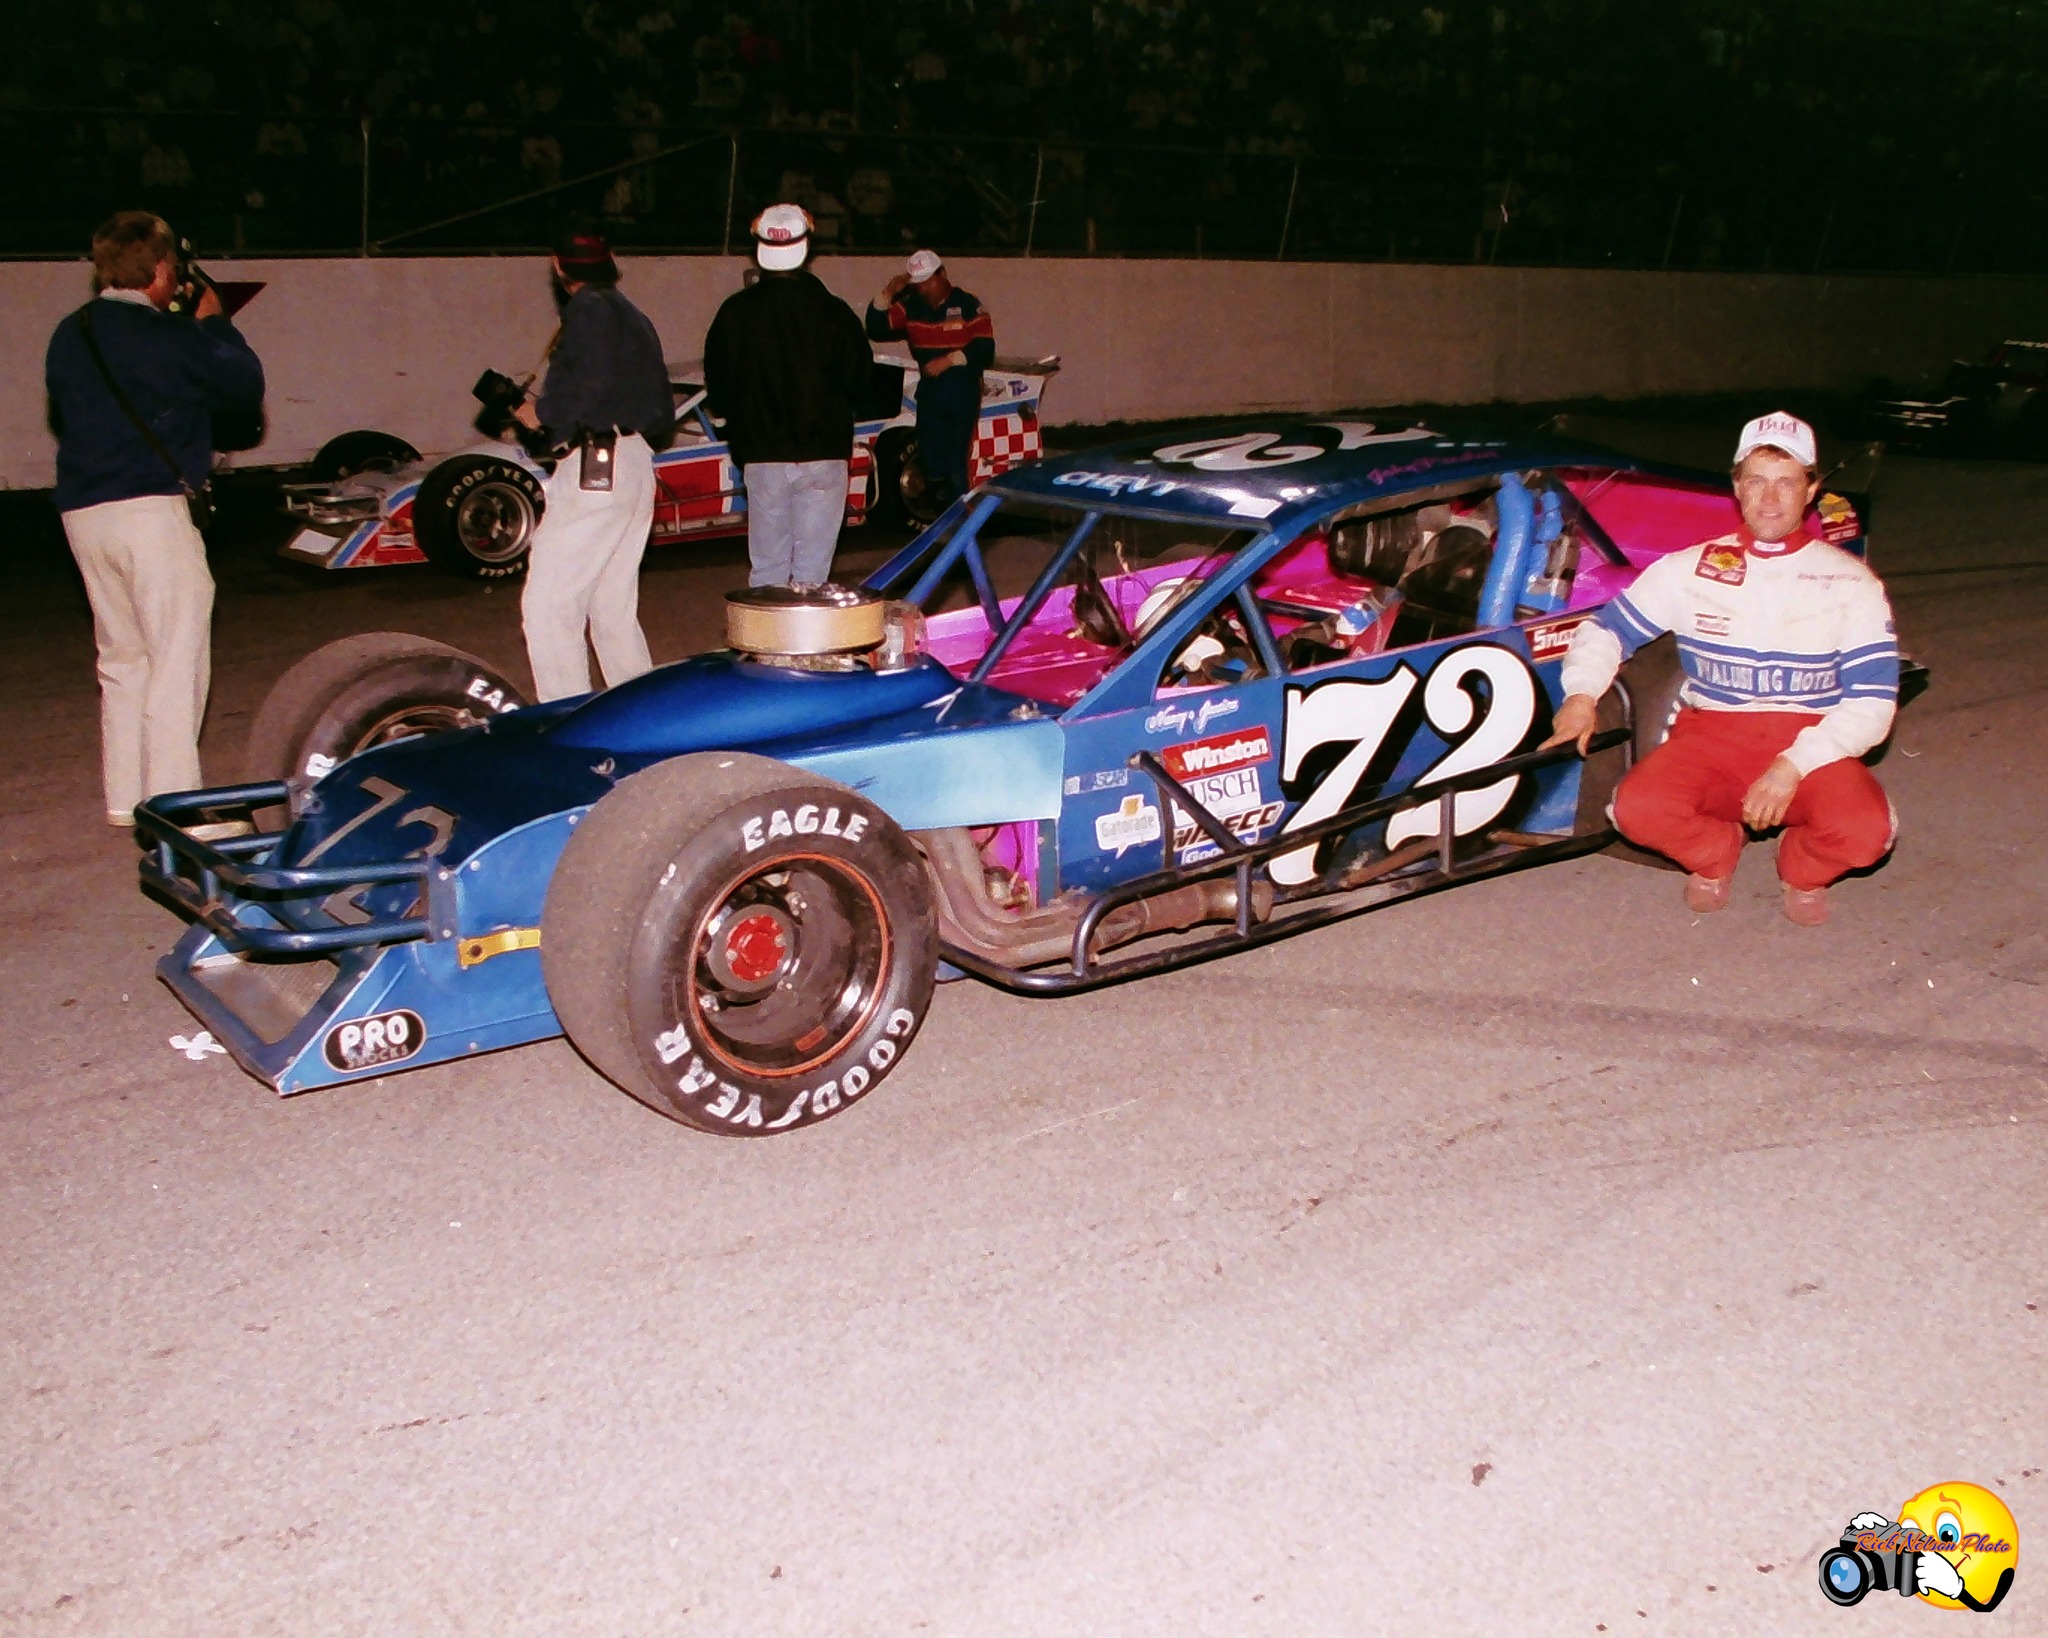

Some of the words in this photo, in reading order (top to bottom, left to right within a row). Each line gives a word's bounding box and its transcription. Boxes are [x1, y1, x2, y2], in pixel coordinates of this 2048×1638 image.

[1756, 418, 1798, 434] Bud
[446, 465, 544, 509] GOODYEAR
[1181, 737, 1269, 773] Winston
[1267, 646, 1538, 886] 72
[1186, 770, 1258, 807] USCH
[743, 804, 869, 852] EAGLE
[1101, 815, 1157, 839] Gatorade
[340, 1015, 409, 1060] PRO
[654, 1008, 914, 1129] GOODYEAR
